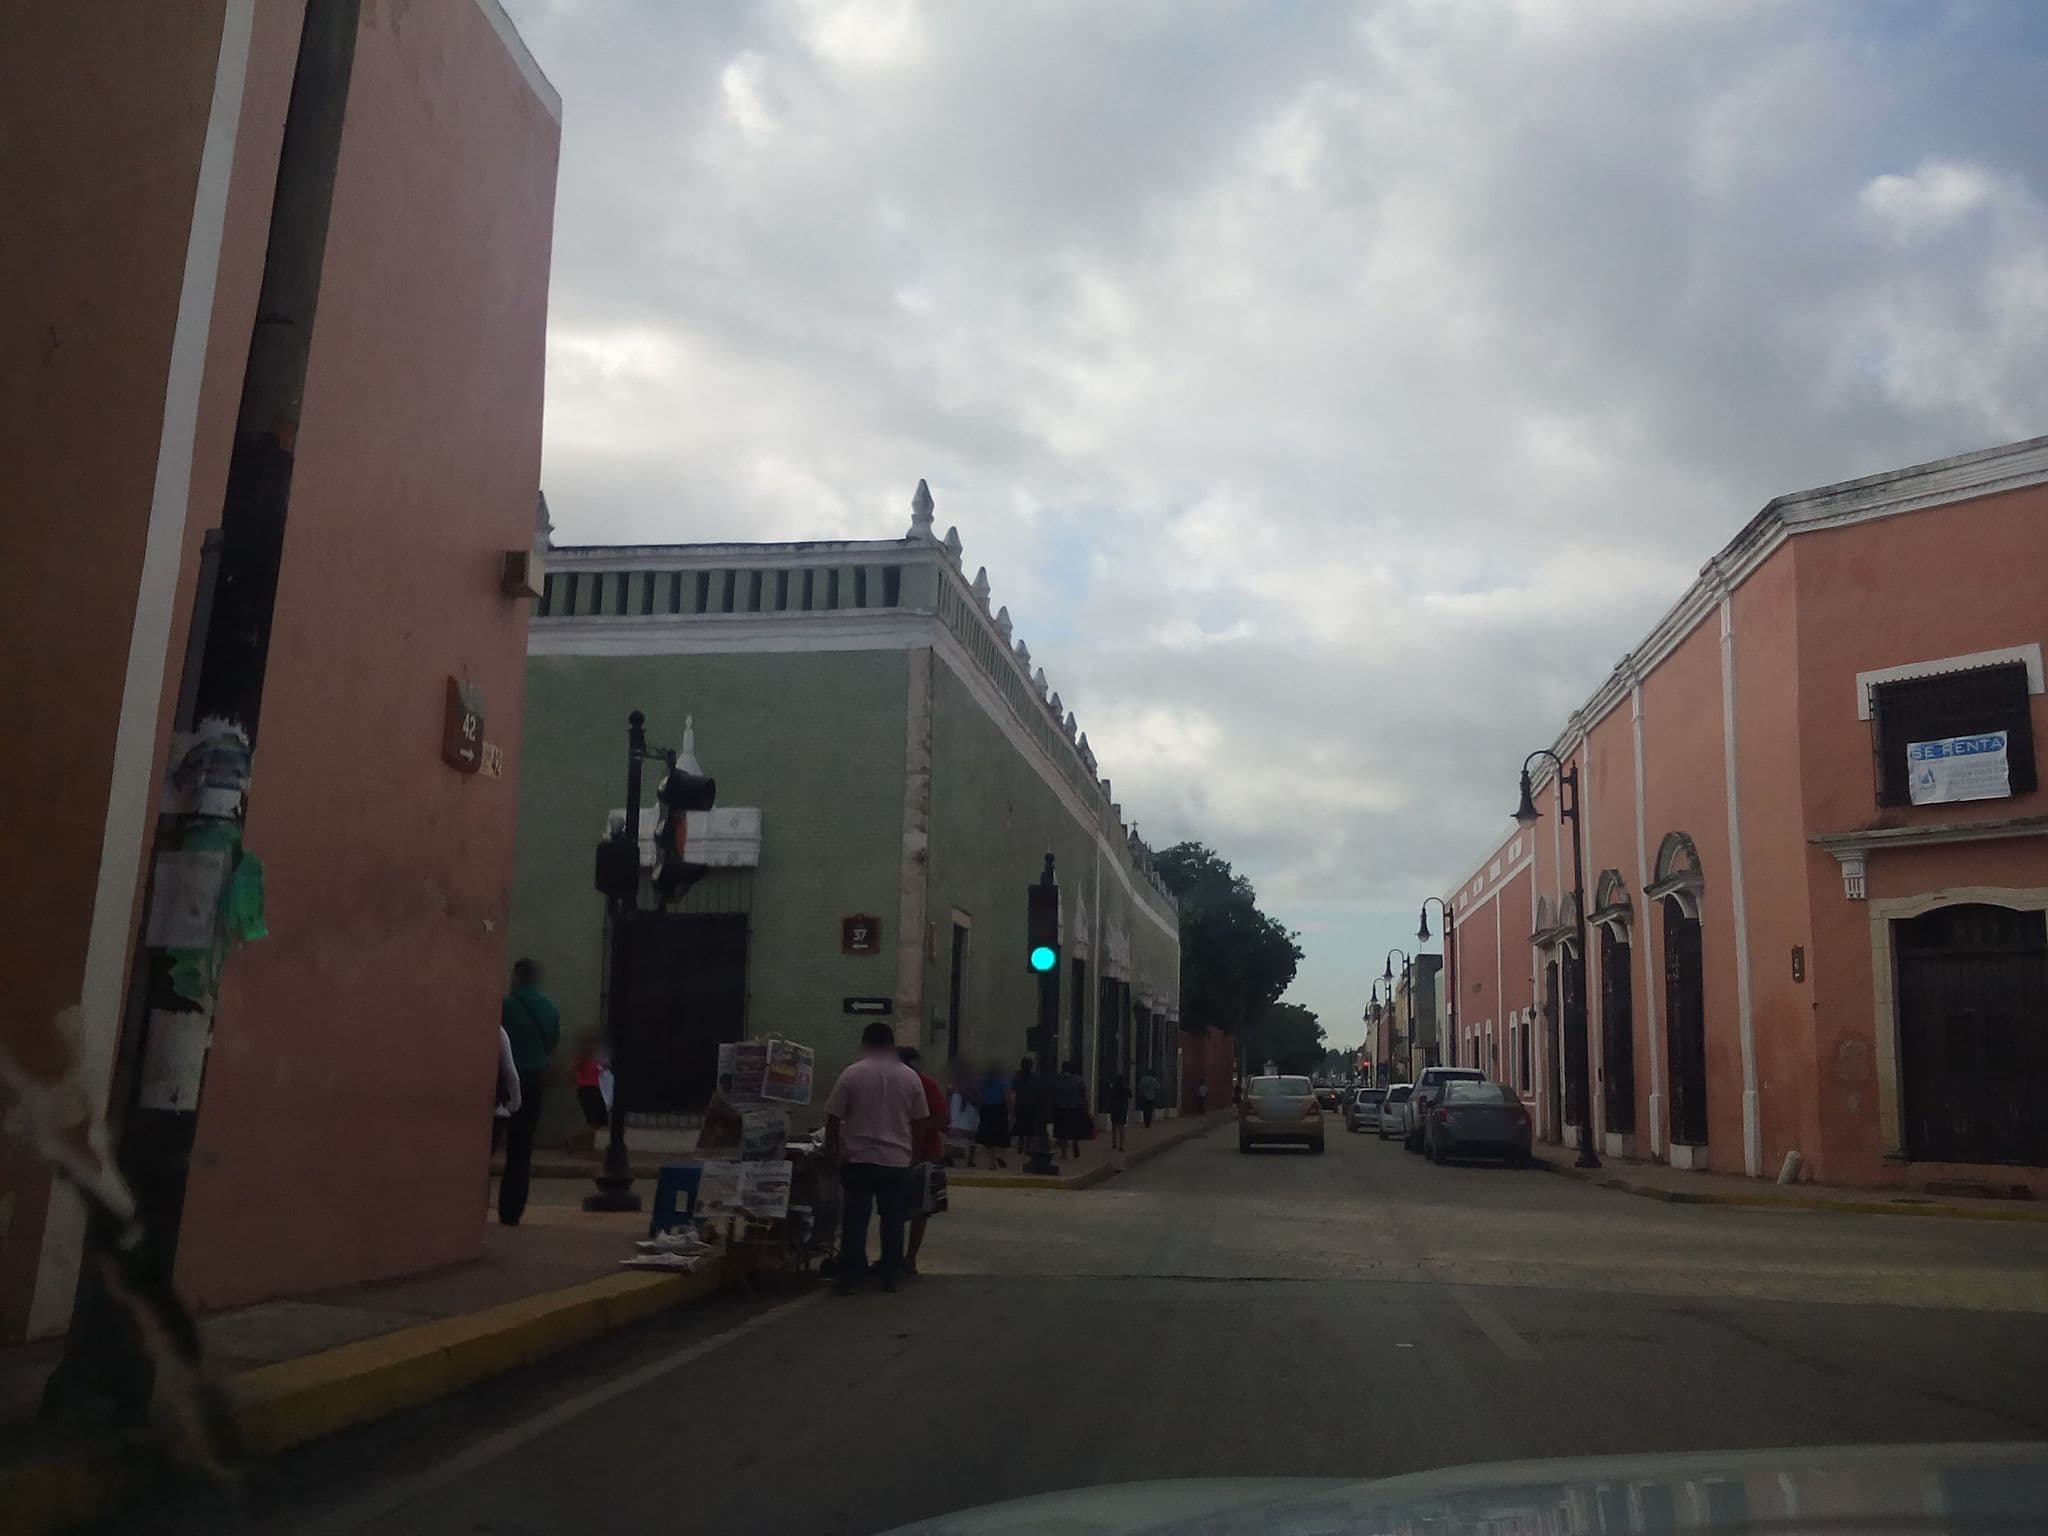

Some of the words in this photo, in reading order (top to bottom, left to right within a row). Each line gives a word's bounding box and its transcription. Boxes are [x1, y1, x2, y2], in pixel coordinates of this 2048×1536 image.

[462, 713, 476, 741] 42
[1911, 747, 1935, 760] SE
[1941, 739, 2003, 756] RENTA
